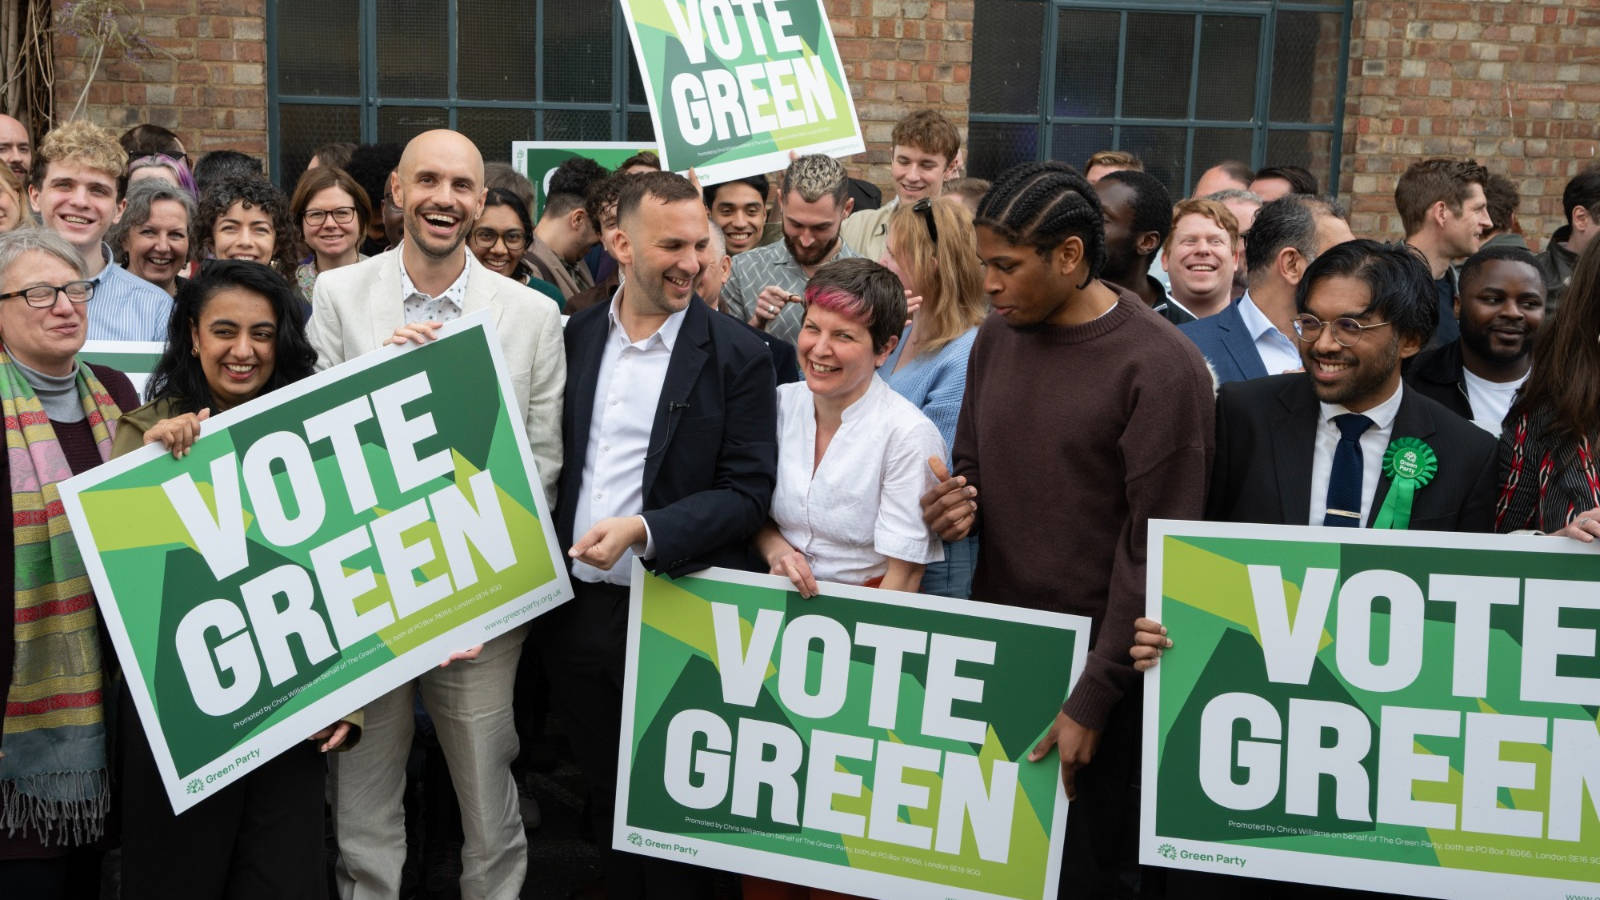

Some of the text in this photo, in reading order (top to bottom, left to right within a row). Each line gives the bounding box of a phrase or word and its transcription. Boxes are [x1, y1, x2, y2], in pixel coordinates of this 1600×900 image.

[664, 0, 804, 64] VOTE
[671, 55, 836, 146] GREEN
[161, 370, 455, 581] VOTE
[1400, 459, 1418, 469] Green
[1400, 465, 1415, 475] Party
[175, 469, 518, 716] GREEN
[484, 588, 562, 632] www.greenparty.org.uk
[1247, 564, 1600, 706] VOTE
[711, 602, 997, 745] VOTE
[205, 747, 260, 784] Green Party
[664, 708, 1019, 864] GREEN
[644, 838, 698, 856] Green Party
[1180, 849, 1247, 868] Green Party
[1228, 819, 1266, 832] Promoted
[1266, 824, 1276, 834] by
[1276, 825, 1298, 834] Chris
[1378, 836, 1394, 845] The
